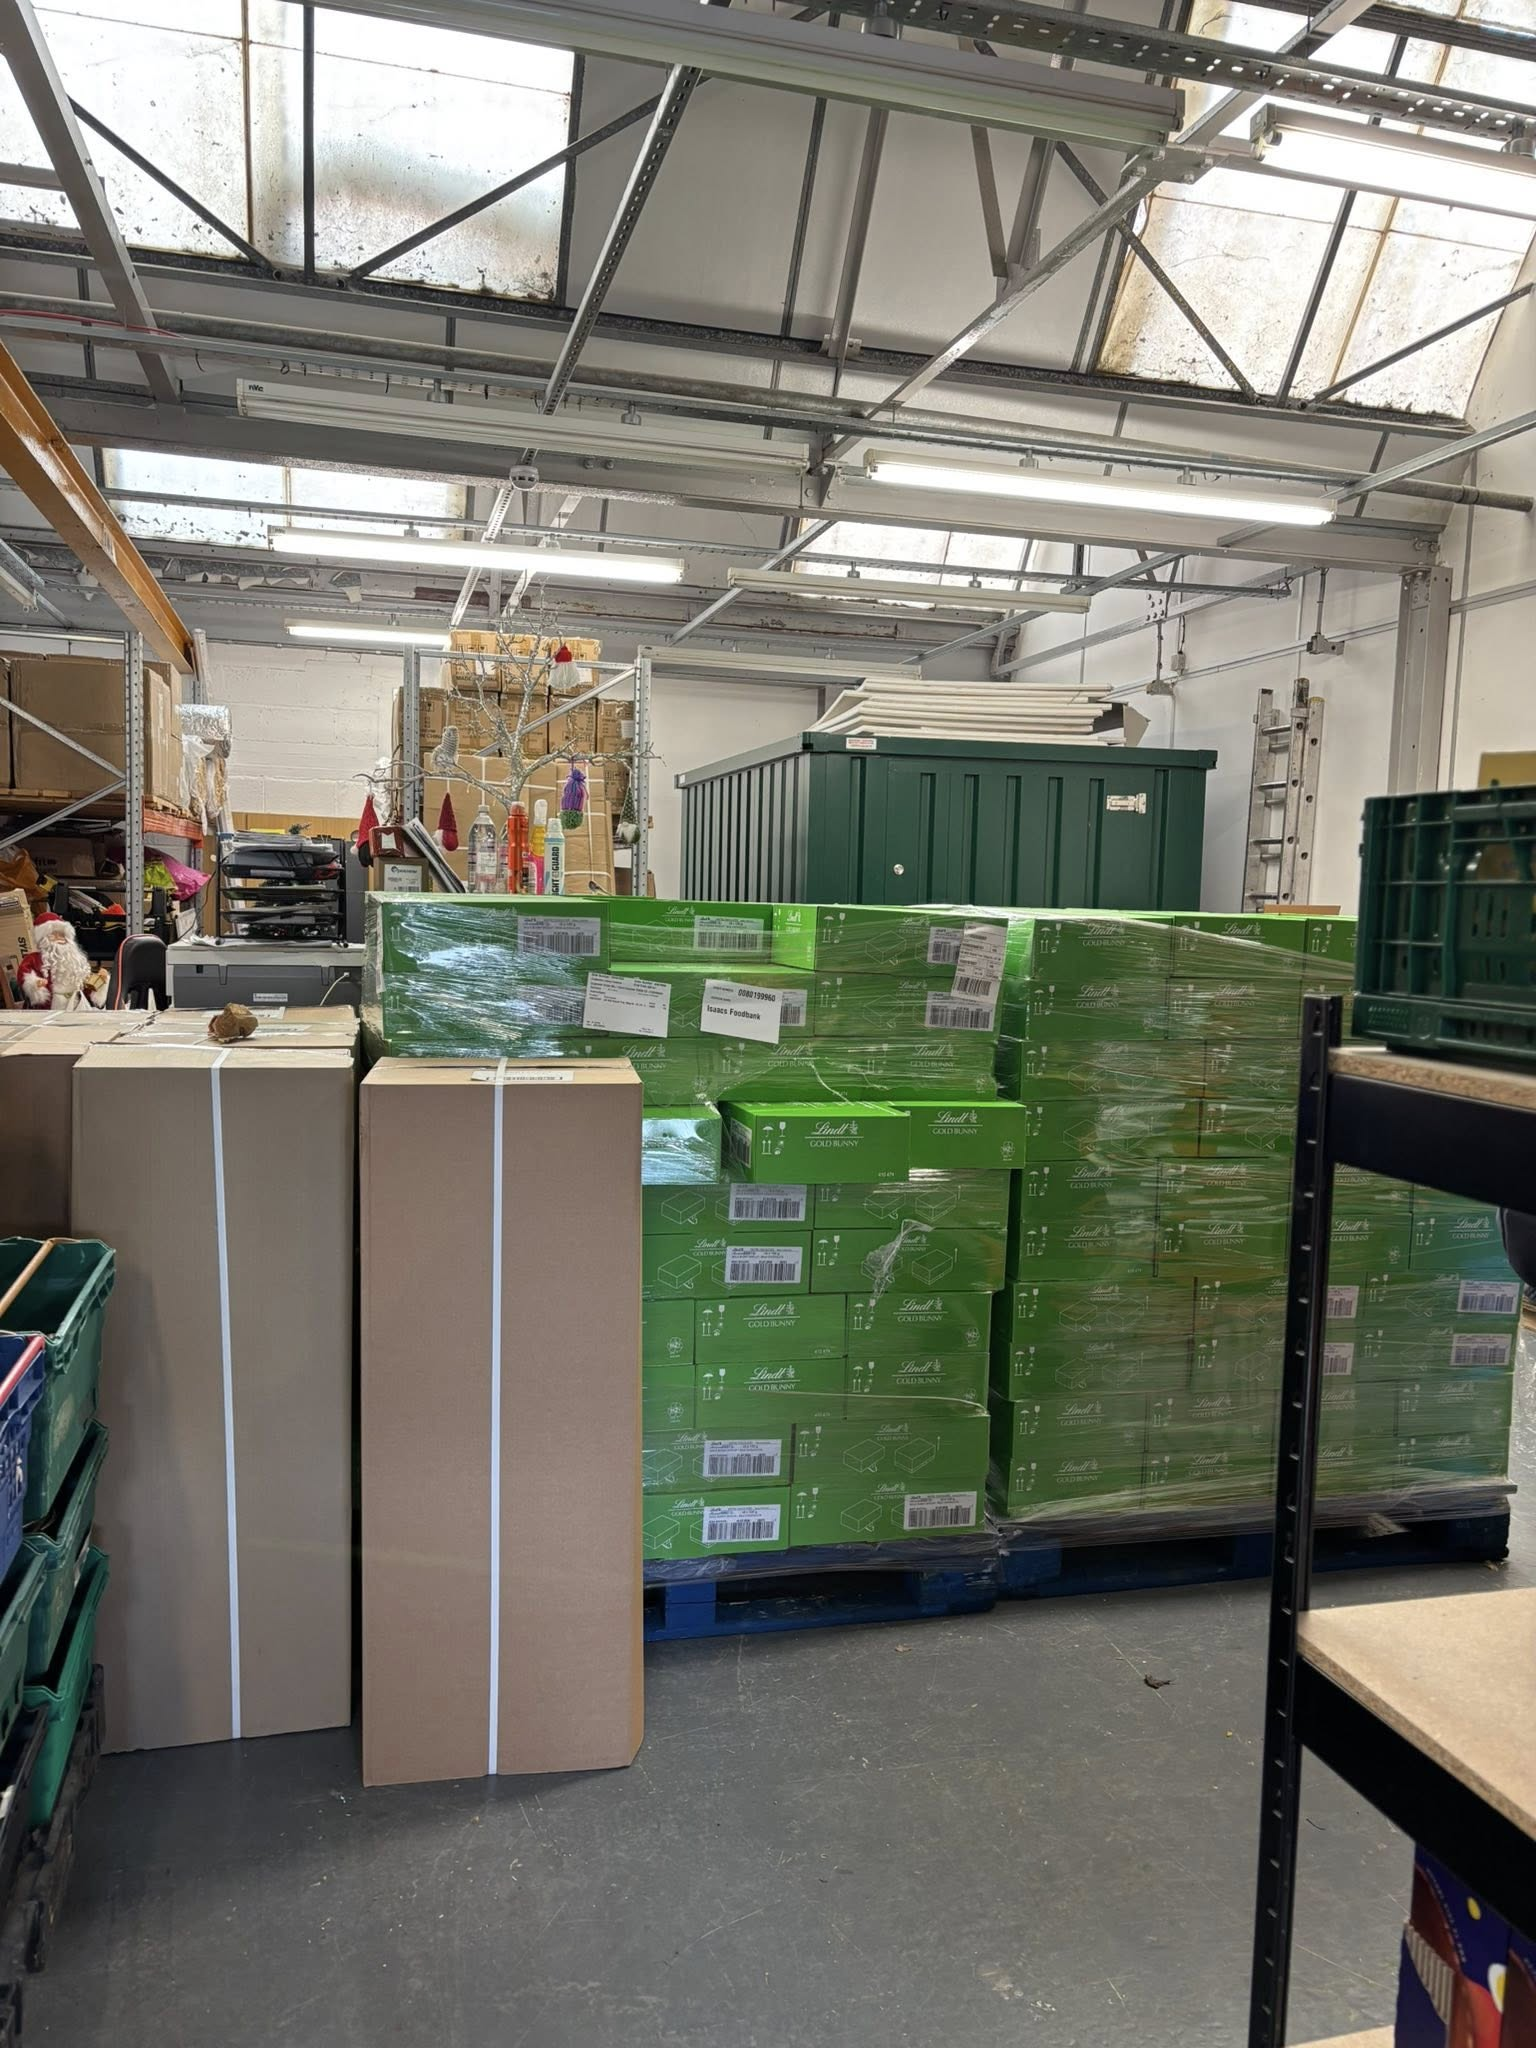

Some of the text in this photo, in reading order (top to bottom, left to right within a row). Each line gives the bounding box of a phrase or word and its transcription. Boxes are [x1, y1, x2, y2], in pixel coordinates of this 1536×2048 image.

[551, 846, 559, 871] GUARD
[666, 905, 689, 915] Lindt
[1222, 921, 1254, 935] Lindt
[738, 989, 776, 1002] 0080199960
[1077, 984, 1111, 997] Lindt
[1216, 985, 1249, 996] Lindt
[1076, 1000, 1120, 1008] GOLD BUNNY
[707, 1004, 761, 1020] Isaacs Foodbank
[622, 1044, 655, 1059] Lindt
[769, 1044, 805, 1056] Lindt
[912, 1044, 946, 1056] Lindt
[768, 1060, 789, 1068] GOLD
[934, 1111, 970, 1124] Lindt
[811, 1121, 850, 1136] Lindt
[932, 1128, 978, 1136] GOLD BUNNY
[810, 1138, 859, 1148] GOLD BUNNY
[1072, 1166, 1104, 1178] Lindt
[1070, 1181, 1112, 1189] GOLD BUNNY
[1206, 1223, 1237, 1234] Lindt
[1332, 1220, 1362, 1232] Lindt
[1454, 1217, 1484, 1229] Lindt
[1070, 1225, 1104, 1238] Lindt
[1452, 1231, 1490, 1240] GOLD BUNNY
[694, 1238, 720, 1248] Lindt
[1068, 1240, 1110, 1249] GOLD BUNNY
[1223, 1238, 1244, 1246] BUNNY
[750, 1303, 786, 1316] Lindt
[899, 1298, 934, 1312] Lindt
[748, 1319, 795, 1328] GOLD BUNNY
[898, 1314, 943, 1323] GOLD BUNNY
[750, 1366, 786, 1379] Lindt
[898, 1361, 933, 1374] Lindt
[896, 1376, 941, 1385] GOLD BUNNY
[748, 1382, 796, 1392] GOLD BUNNY
[1193, 1396, 1224, 1408] Lindt
[1061, 1402, 1094, 1415] Lindt
[1060, 1418, 1079, 1426] GOLD
[877, 1424, 903, 1433] Lindt
[1192, 1453, 1220, 1465] Lindt
[1058, 1460, 1090, 1473] Lindt
[1056, 1474, 1098, 1483] GOLD BUNNY
[875, 1483, 900, 1493] Lindt
[671, 1499, 699, 1510] Lindt
